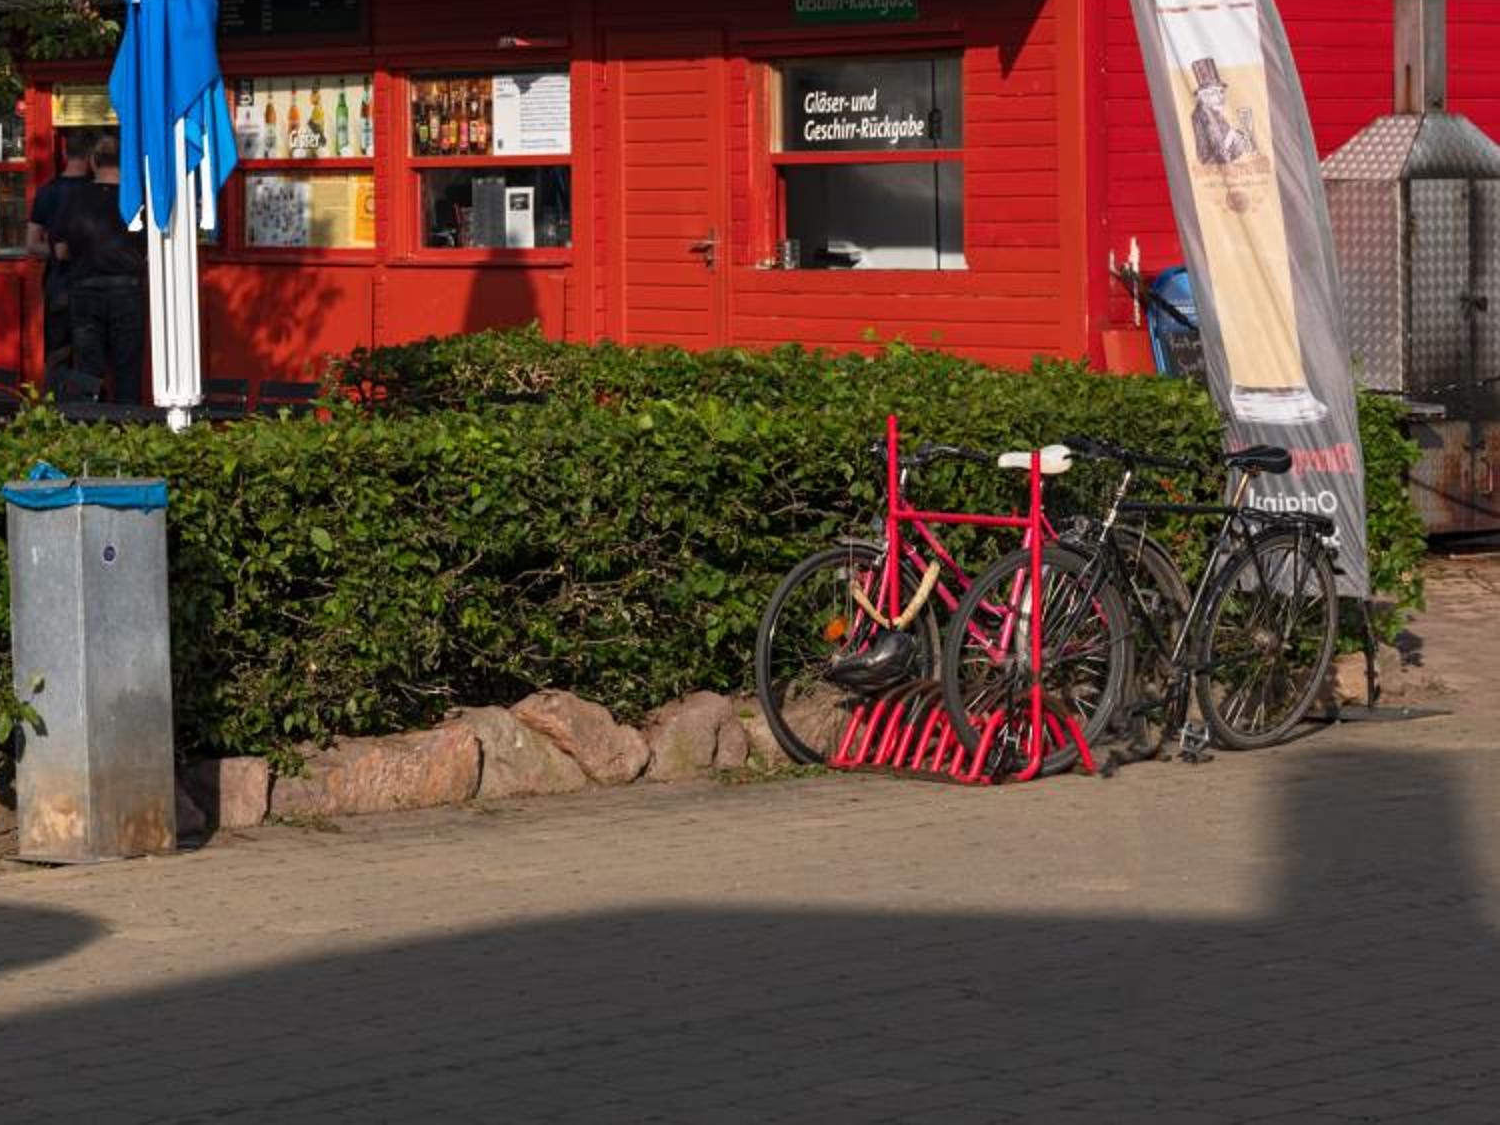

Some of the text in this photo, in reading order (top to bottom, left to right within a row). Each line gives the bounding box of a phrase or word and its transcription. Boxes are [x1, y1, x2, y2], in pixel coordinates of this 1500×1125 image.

[804, 87, 878, 115] Gläser- und
[804, 113, 926, 145] Geschirr-Rückgabe
